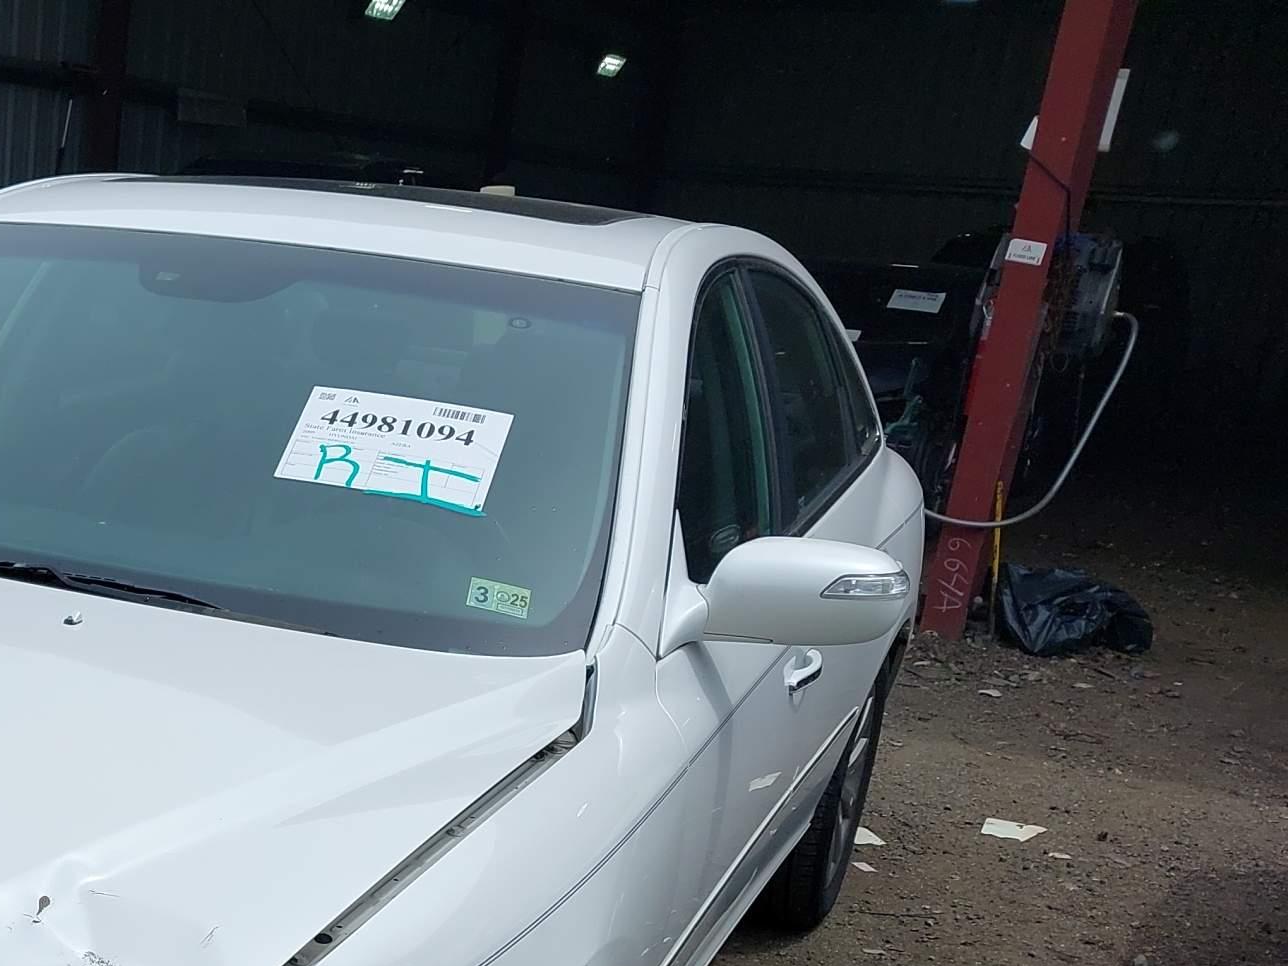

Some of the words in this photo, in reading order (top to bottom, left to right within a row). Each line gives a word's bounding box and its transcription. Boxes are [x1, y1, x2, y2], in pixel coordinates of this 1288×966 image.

[320, 409, 476, 446] 44981094
[474, 586, 489, 603] 3
[510, 593, 529, 609] 25
